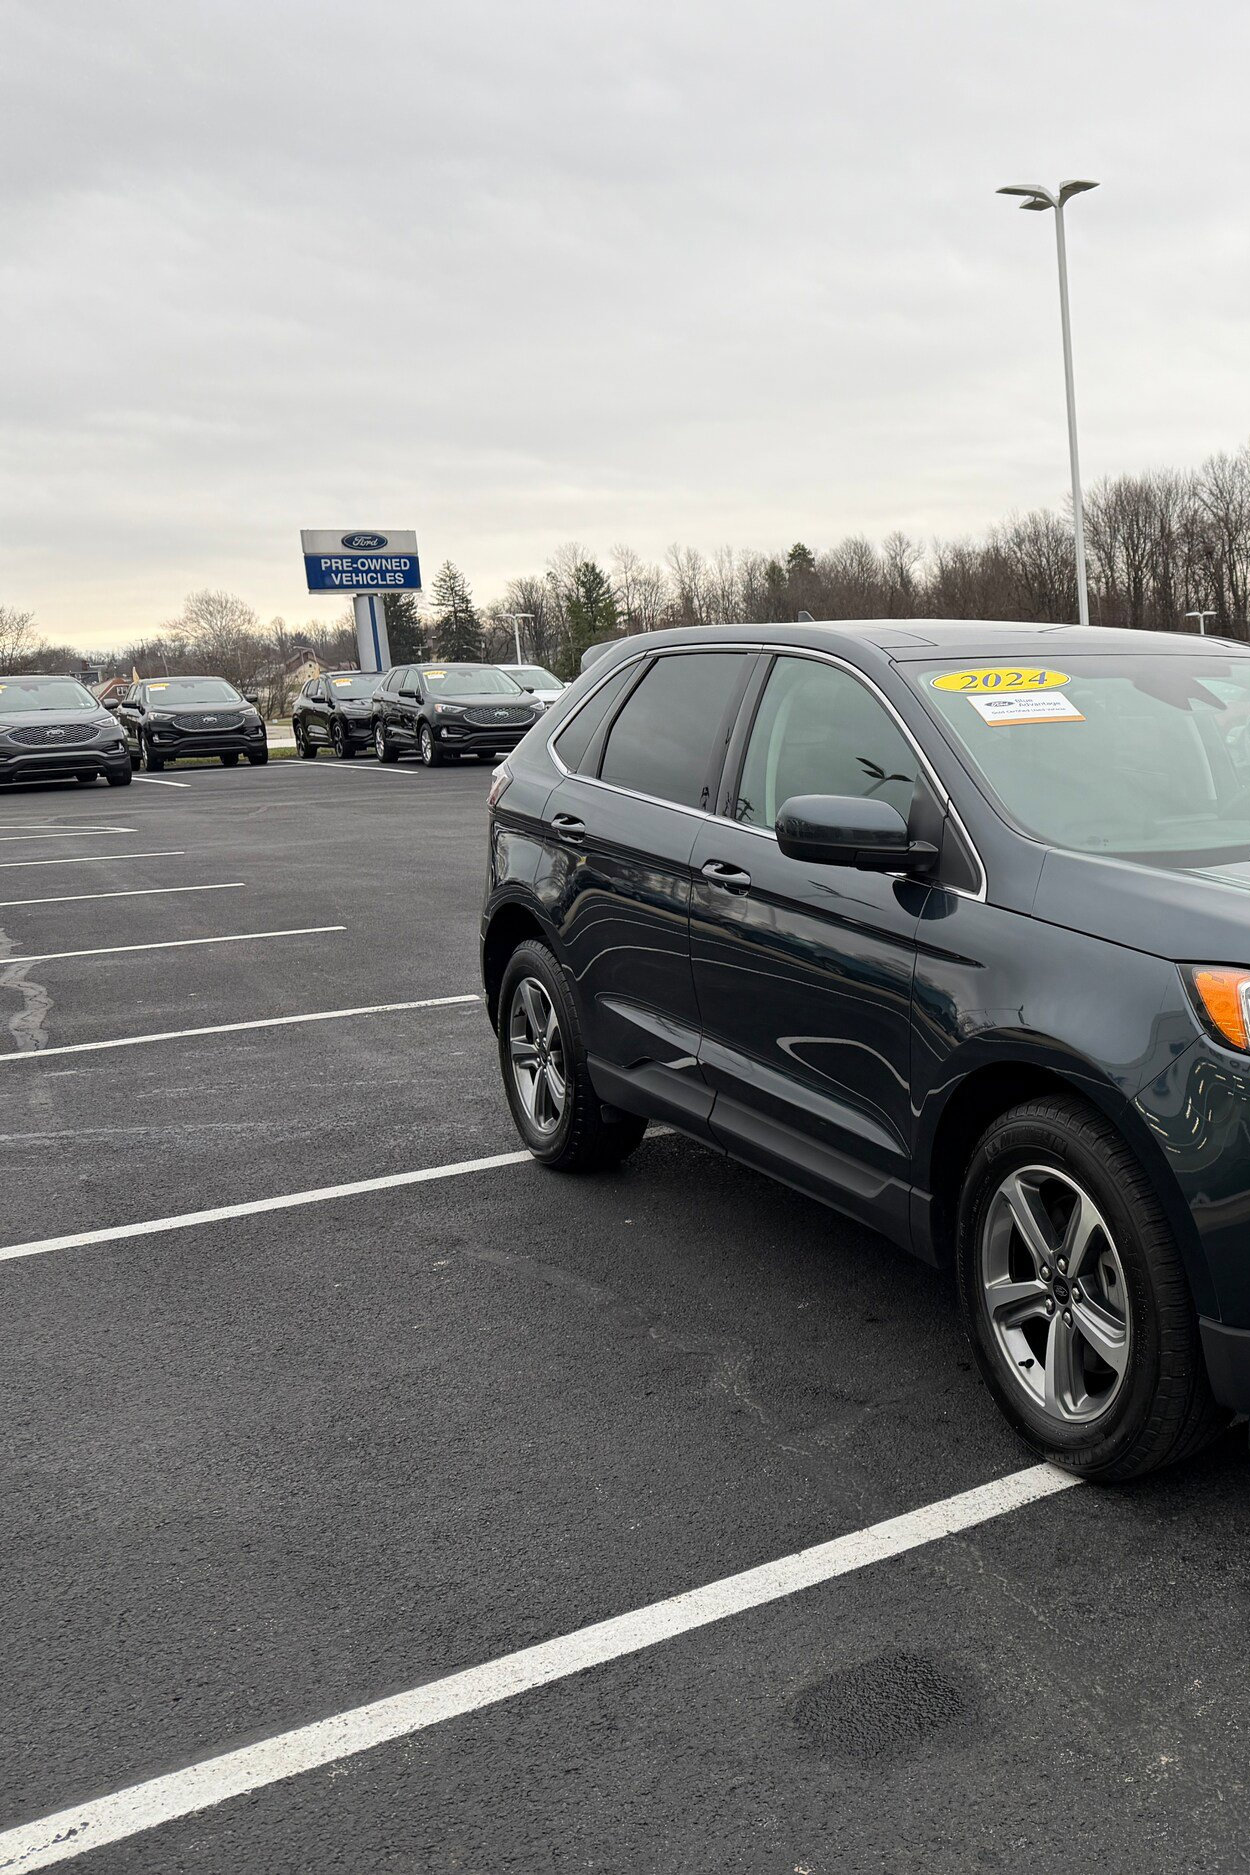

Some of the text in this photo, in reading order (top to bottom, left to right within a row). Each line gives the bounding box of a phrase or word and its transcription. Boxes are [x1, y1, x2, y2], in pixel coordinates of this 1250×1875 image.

[352, 535, 379, 547] Ford
[321, 558, 410, 571] PRE-OWNED
[331, 573, 404, 585] VEHICLES
[960, 671, 1048, 690] 2024
